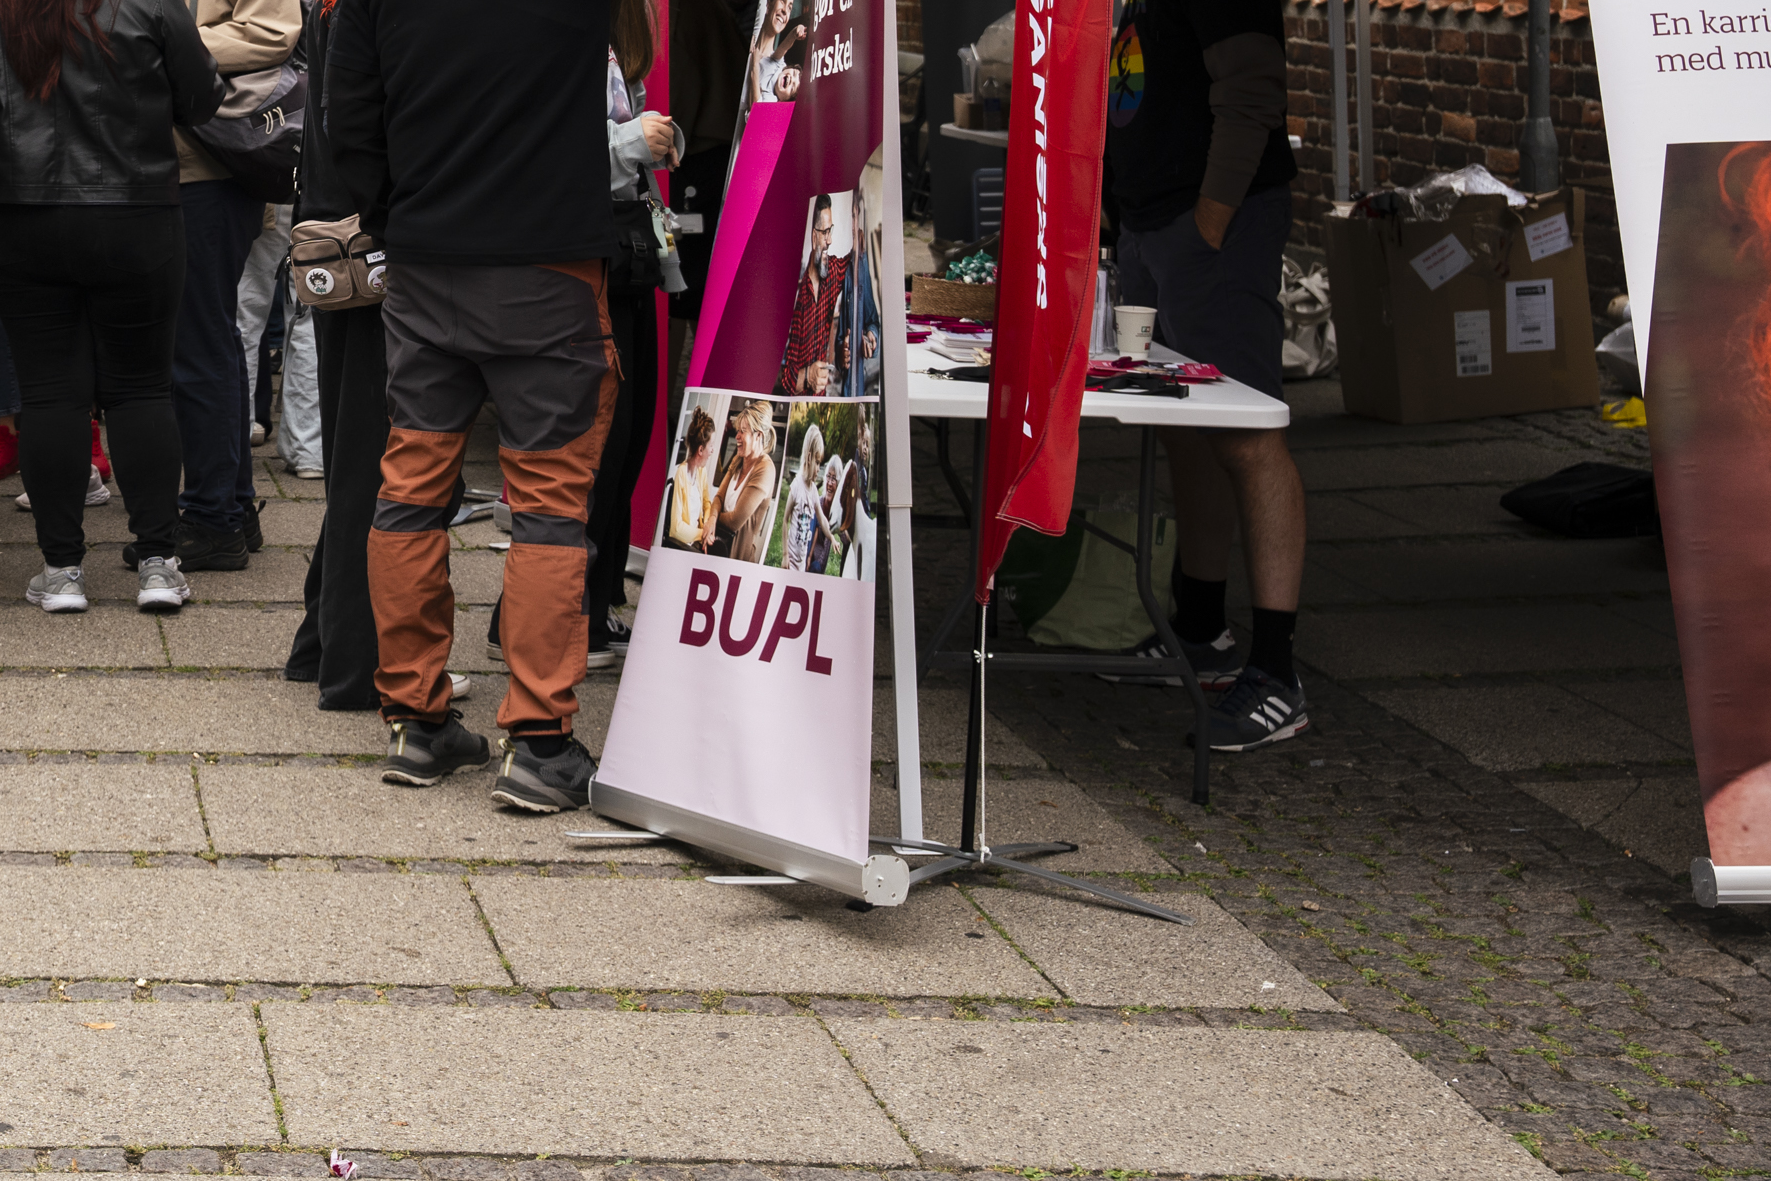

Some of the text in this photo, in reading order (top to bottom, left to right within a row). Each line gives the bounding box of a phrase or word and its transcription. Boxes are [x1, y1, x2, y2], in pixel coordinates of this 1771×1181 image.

[1650, 12, 1693, 36] En
[810, 27, 853, 82] forskel
[1655, 45, 1726, 73] med
[679, 568, 832, 676] BUPL
